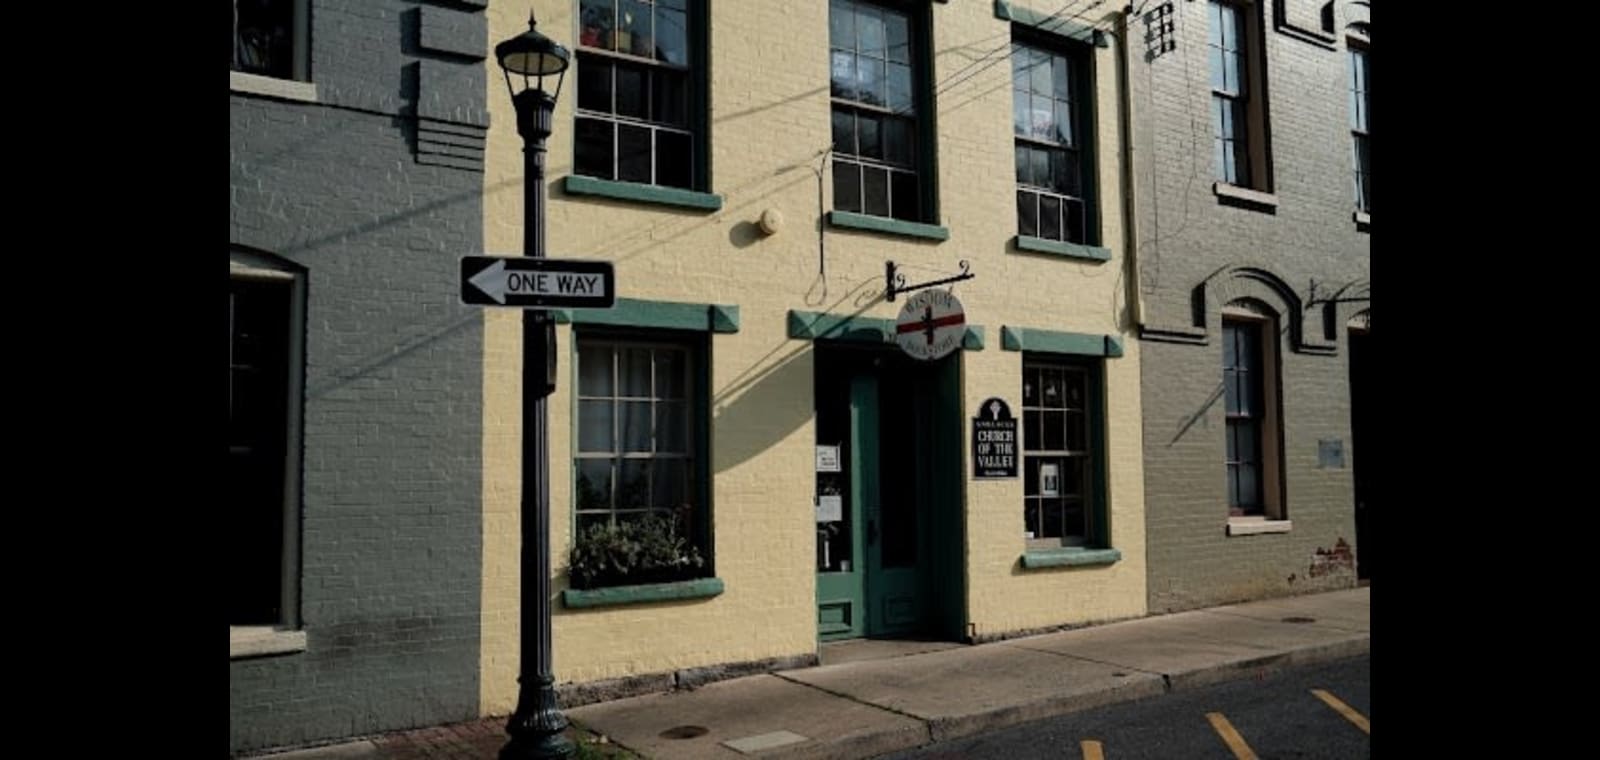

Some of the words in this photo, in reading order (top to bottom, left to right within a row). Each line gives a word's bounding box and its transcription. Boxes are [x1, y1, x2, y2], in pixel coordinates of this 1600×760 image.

[508, 273, 549, 292] ONE
[556, 275, 598, 293] WAY
[905, 291, 953, 312] WISDOM
[977, 430, 1014, 442] CHURCH
[978, 443, 990, 454] OF
[993, 443, 1014, 454] THE
[977, 455, 1014, 468] VALLEY
